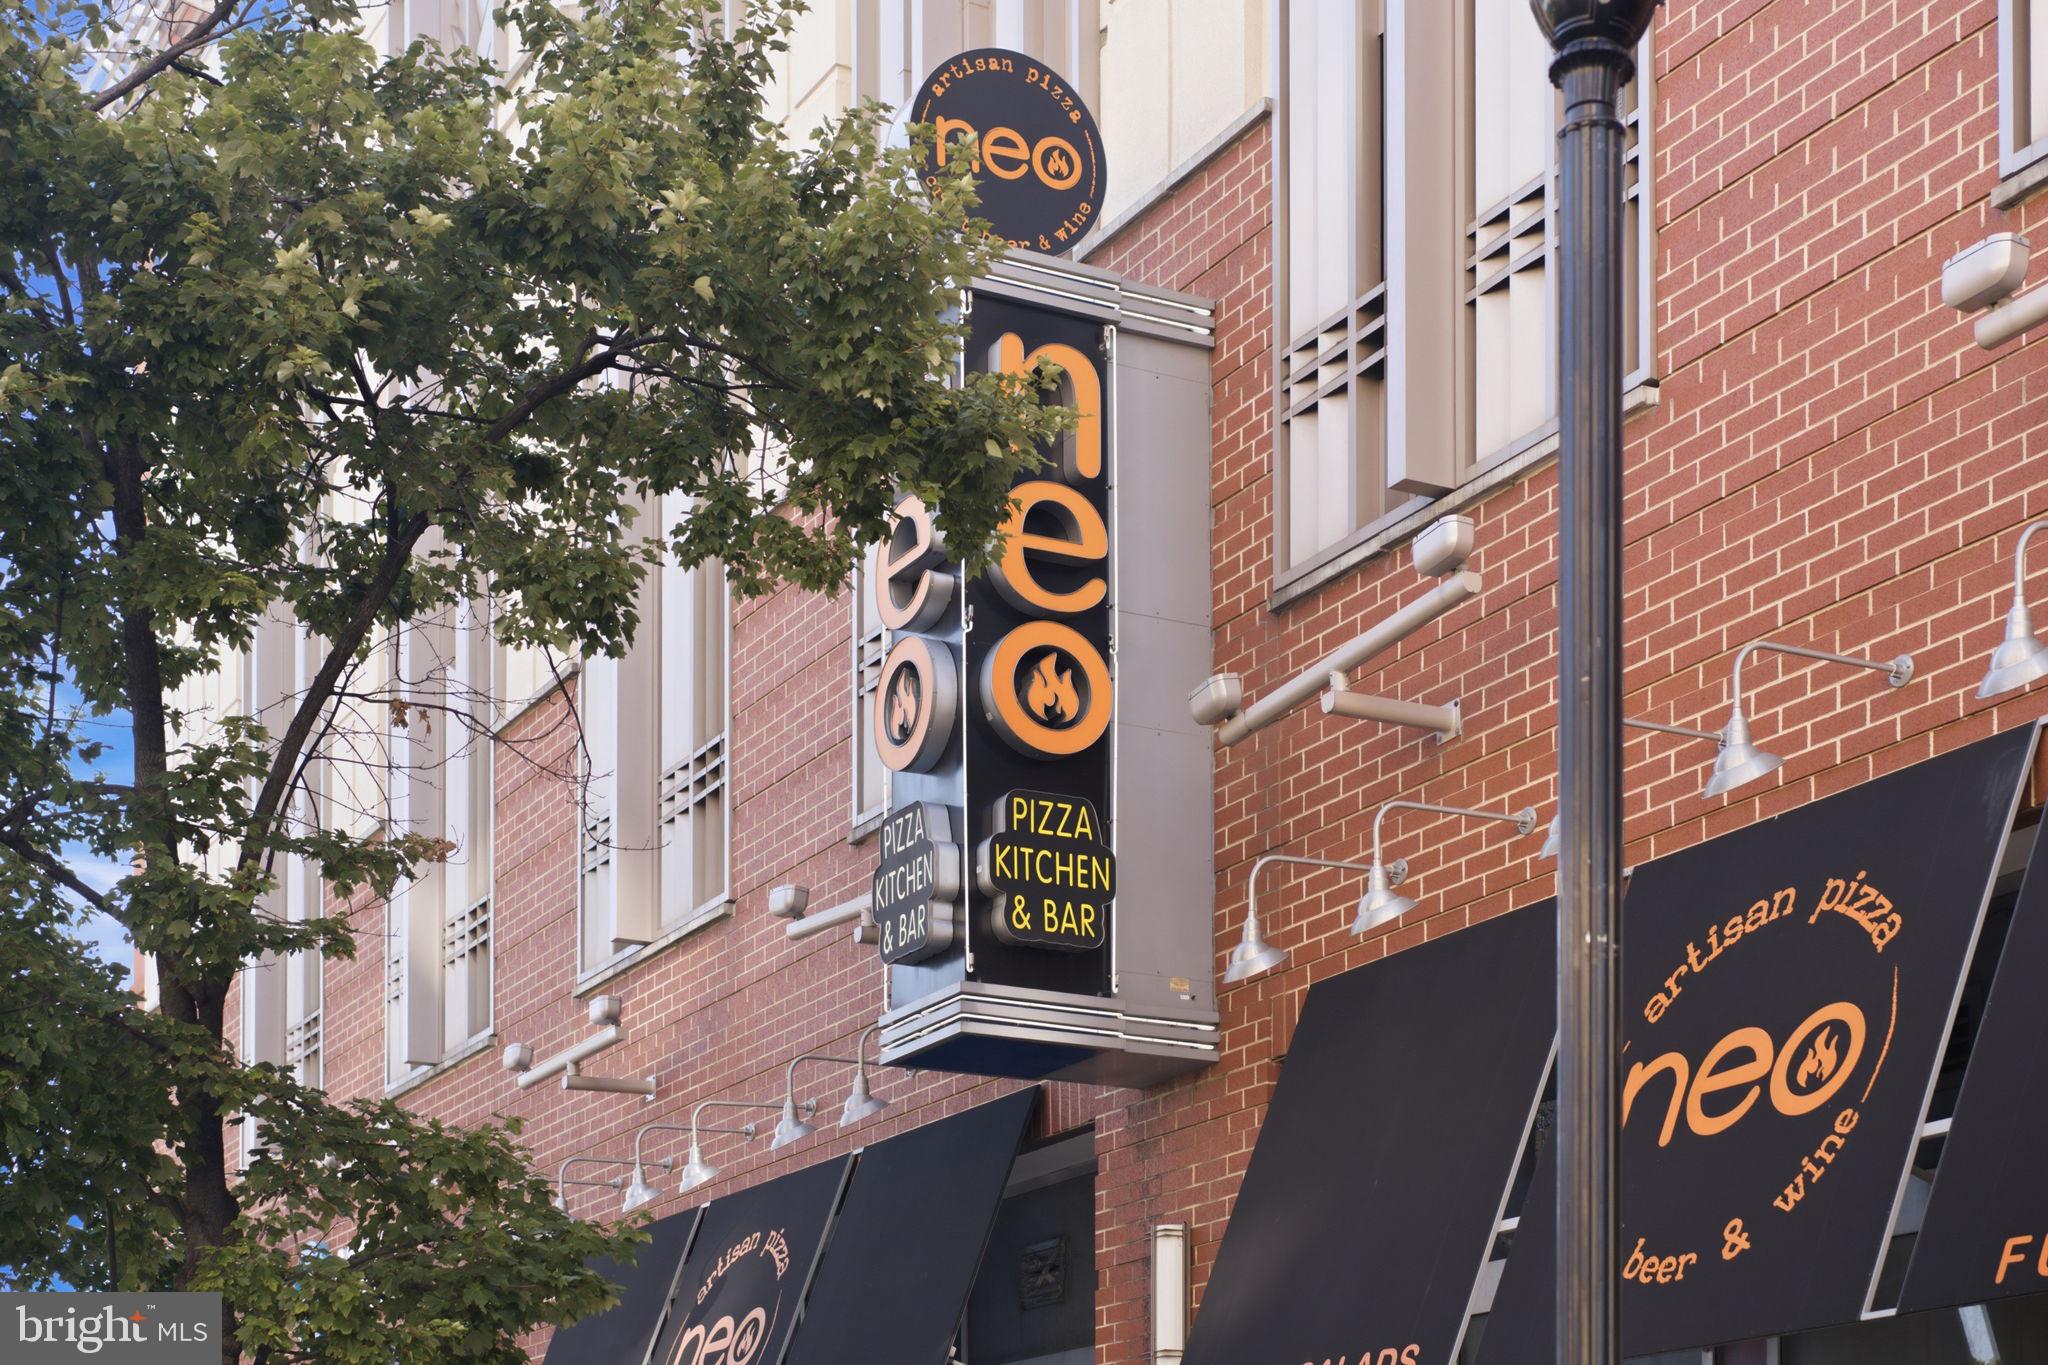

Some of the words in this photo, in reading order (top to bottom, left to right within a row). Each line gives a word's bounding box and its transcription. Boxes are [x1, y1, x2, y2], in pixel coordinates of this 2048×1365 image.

[931, 56, 1014, 97] artisan
[1025, 66, 1082, 124] pizza
[935, 114, 1083, 191] neo
[1039, 234, 1051, 251] &
[1054, 201, 1092, 243] wine
[883, 808, 925, 859] PIZZA
[1012, 797, 1093, 841] PIZZA
[875, 850, 934, 911] KITCHEN
[995, 844, 1110, 892] KITCHEN
[883, 920, 894, 955] &
[899, 904, 926, 948] BAR
[1011, 895, 1031, 930] &
[1043, 898, 1096, 938] BAR
[1644, 885, 1797, 1024] artisan
[1808, 870, 1902, 953] pizza
[1622, 1001, 1866, 1147] neo
[1622, 1237, 1697, 1284] beer
[1721, 1217, 1751, 1261] &
[1773, 1107, 1860, 1214] wine
[697, 1231, 761, 1304] artisan
[760, 1227, 790, 1281] pizza
